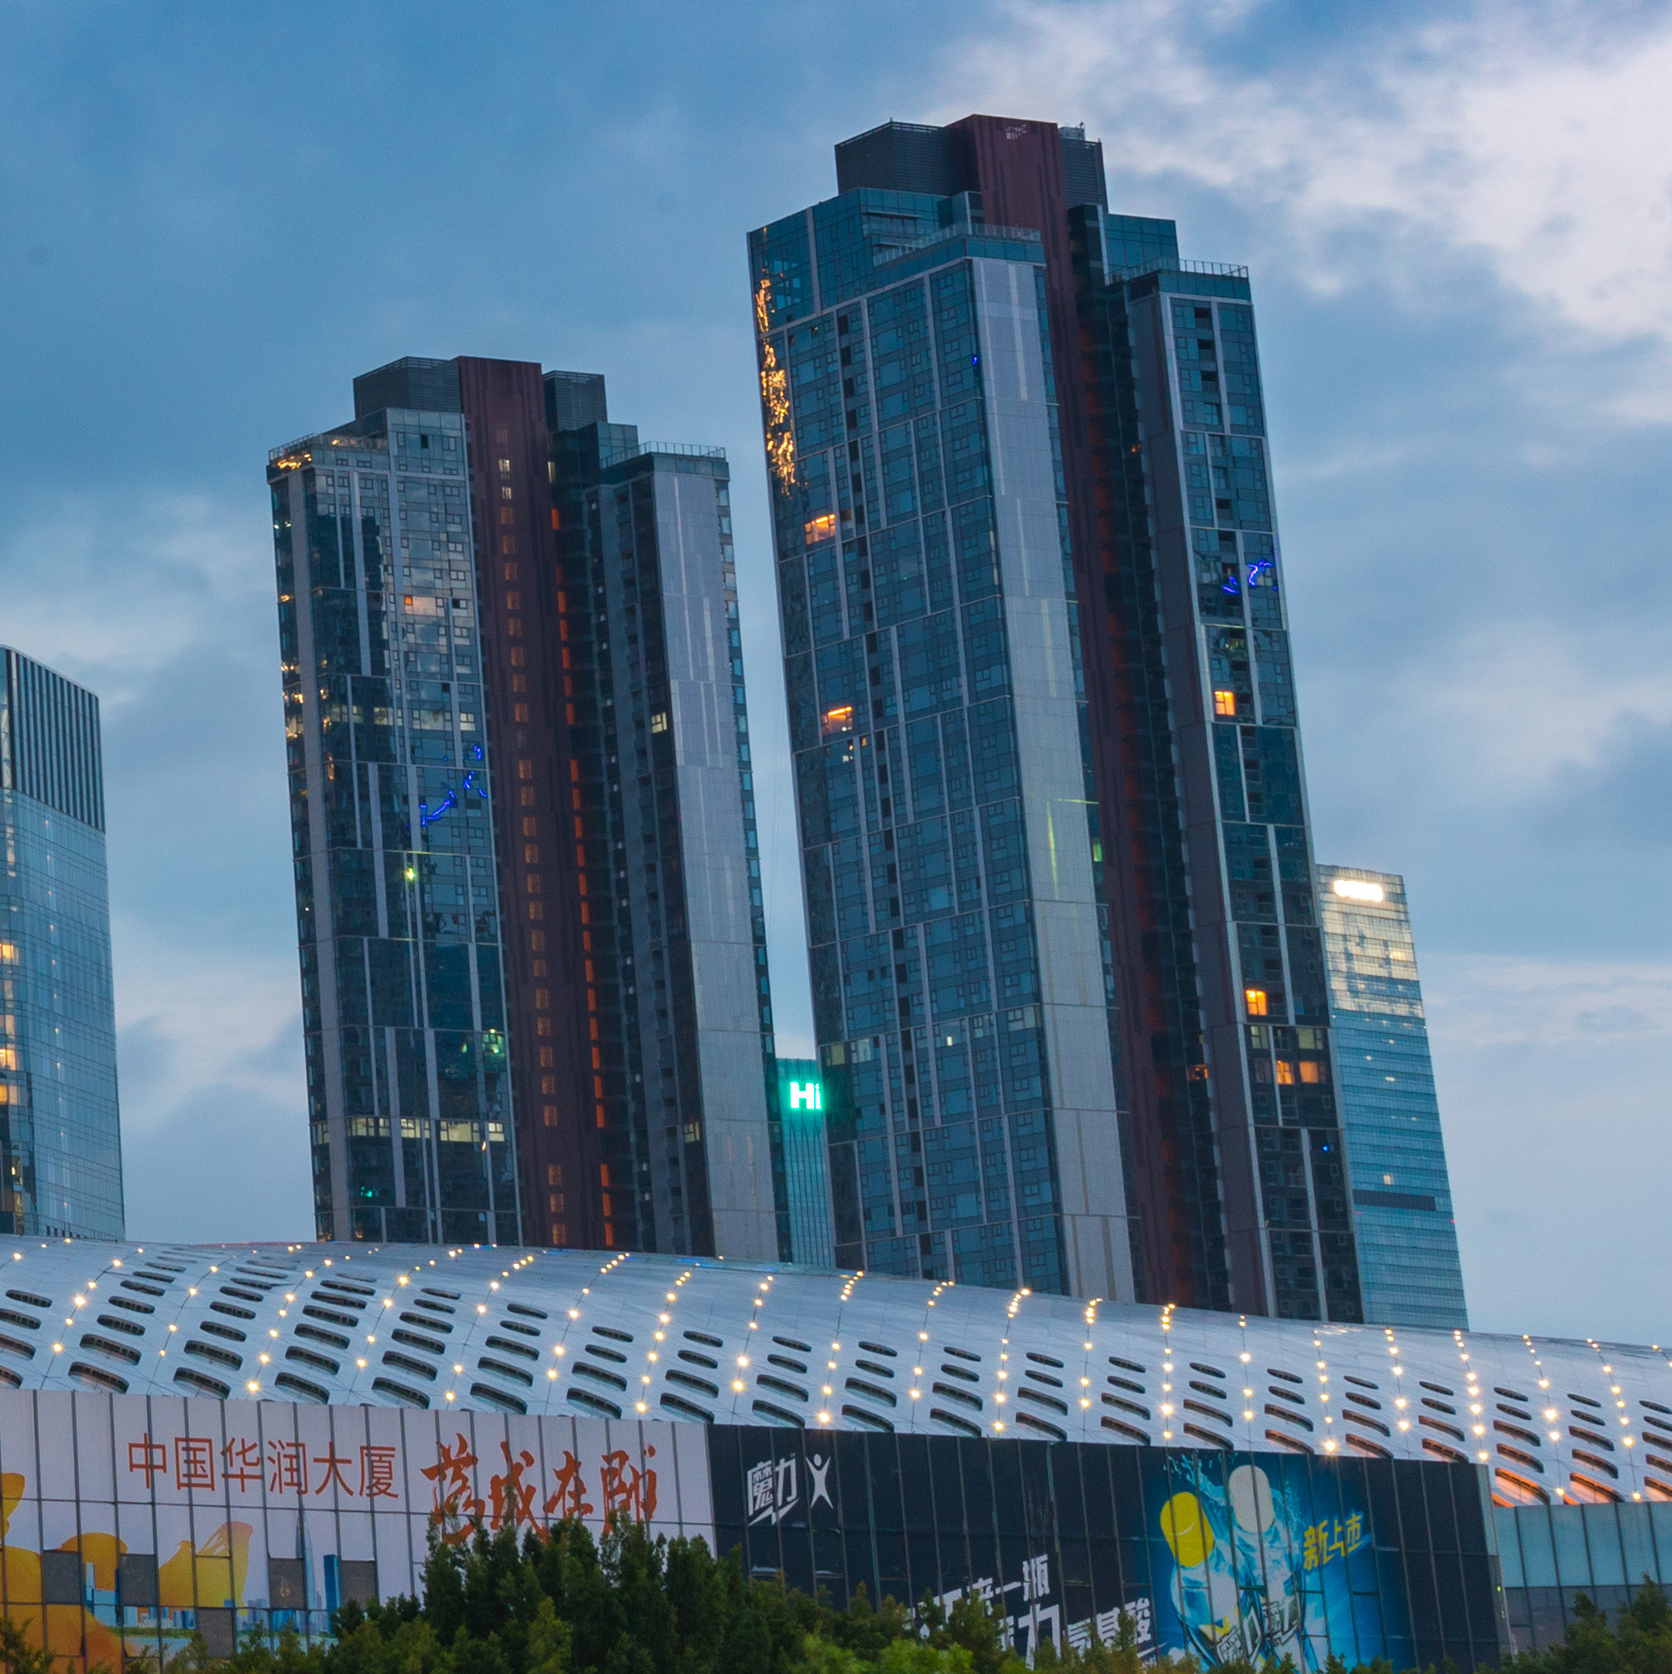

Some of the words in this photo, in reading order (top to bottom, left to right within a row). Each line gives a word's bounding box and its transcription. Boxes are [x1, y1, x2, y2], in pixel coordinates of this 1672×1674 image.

[127, 1432, 400, 1499] 中国华润大厦
[1302, 1512, 1366, 1571] 新上市
